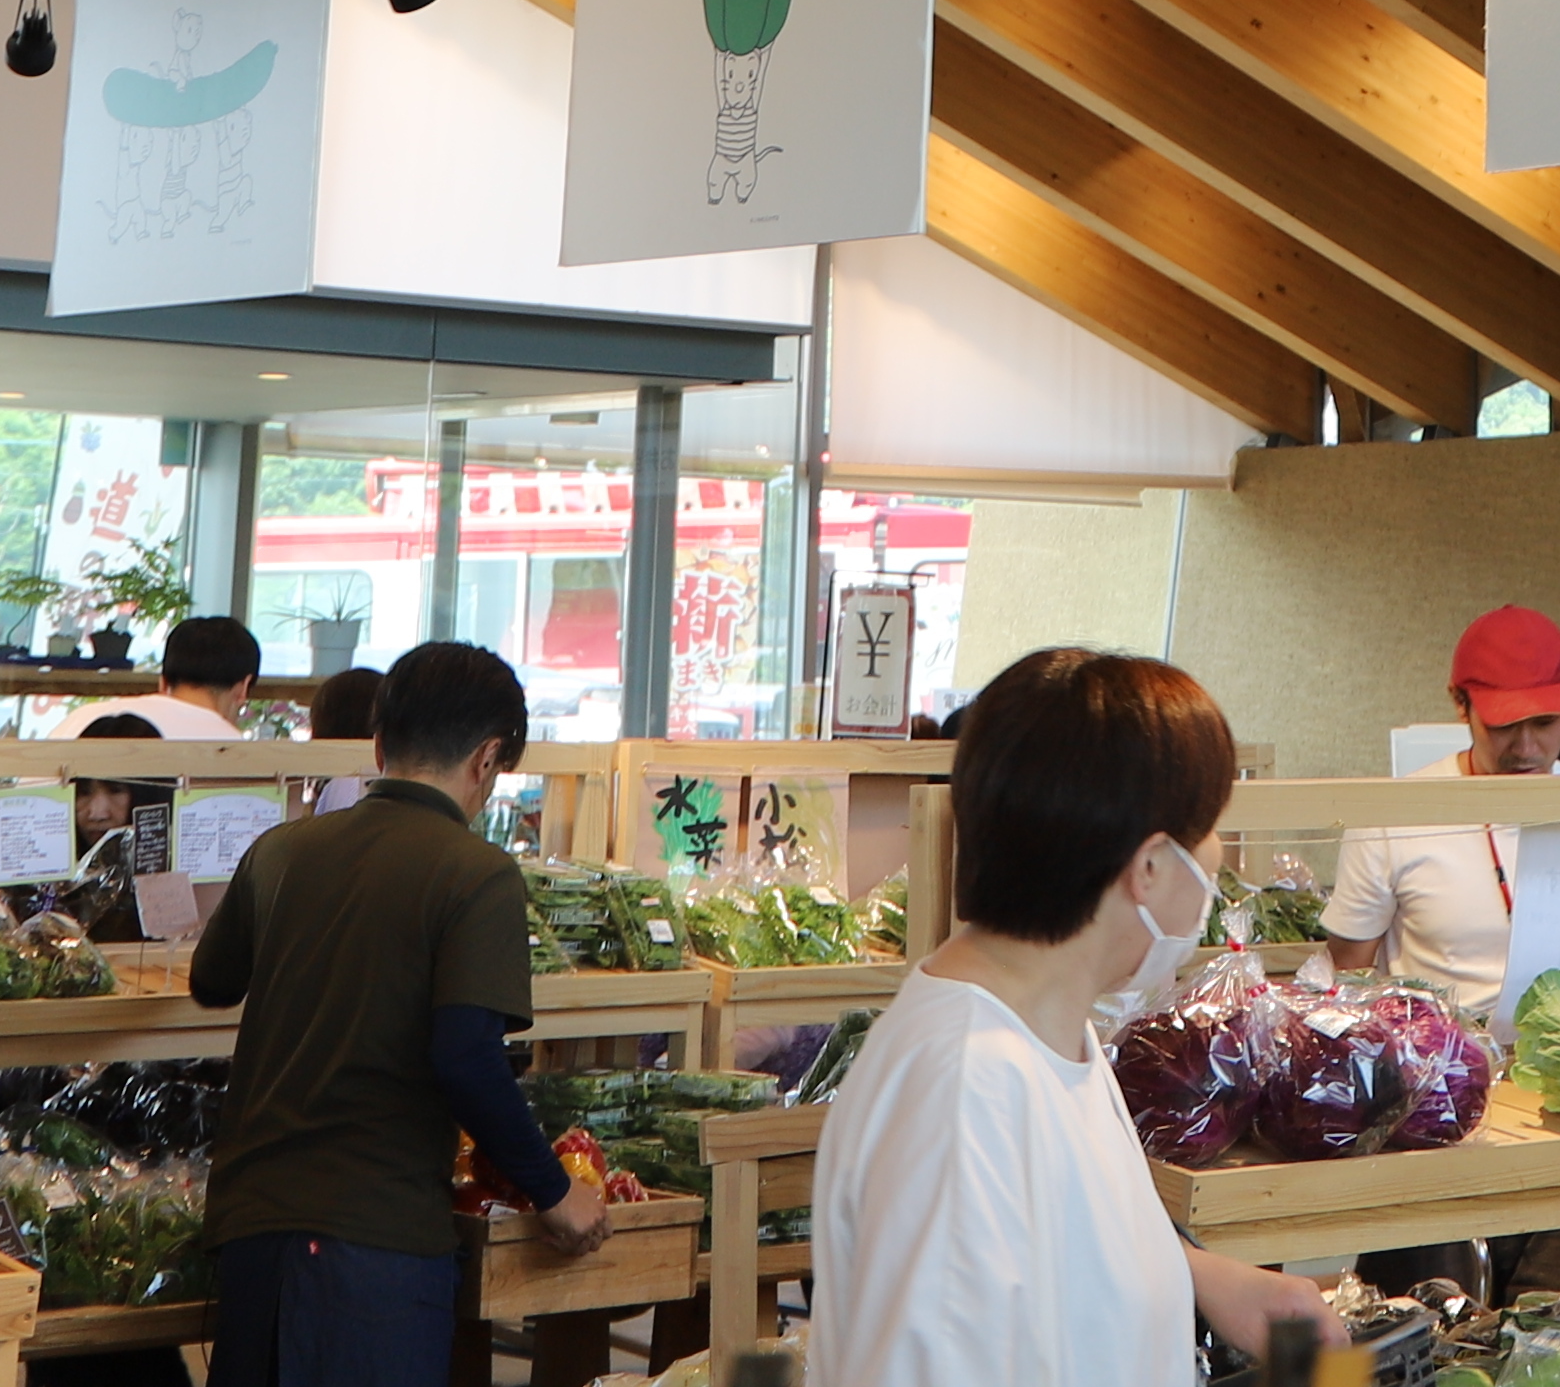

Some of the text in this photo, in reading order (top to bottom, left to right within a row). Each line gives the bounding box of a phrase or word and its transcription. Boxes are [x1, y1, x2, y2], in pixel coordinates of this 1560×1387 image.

[855, 610, 896, 678] ¥
[844, 693, 898, 717] お会計
[655, 774, 728, 871] 水菜
